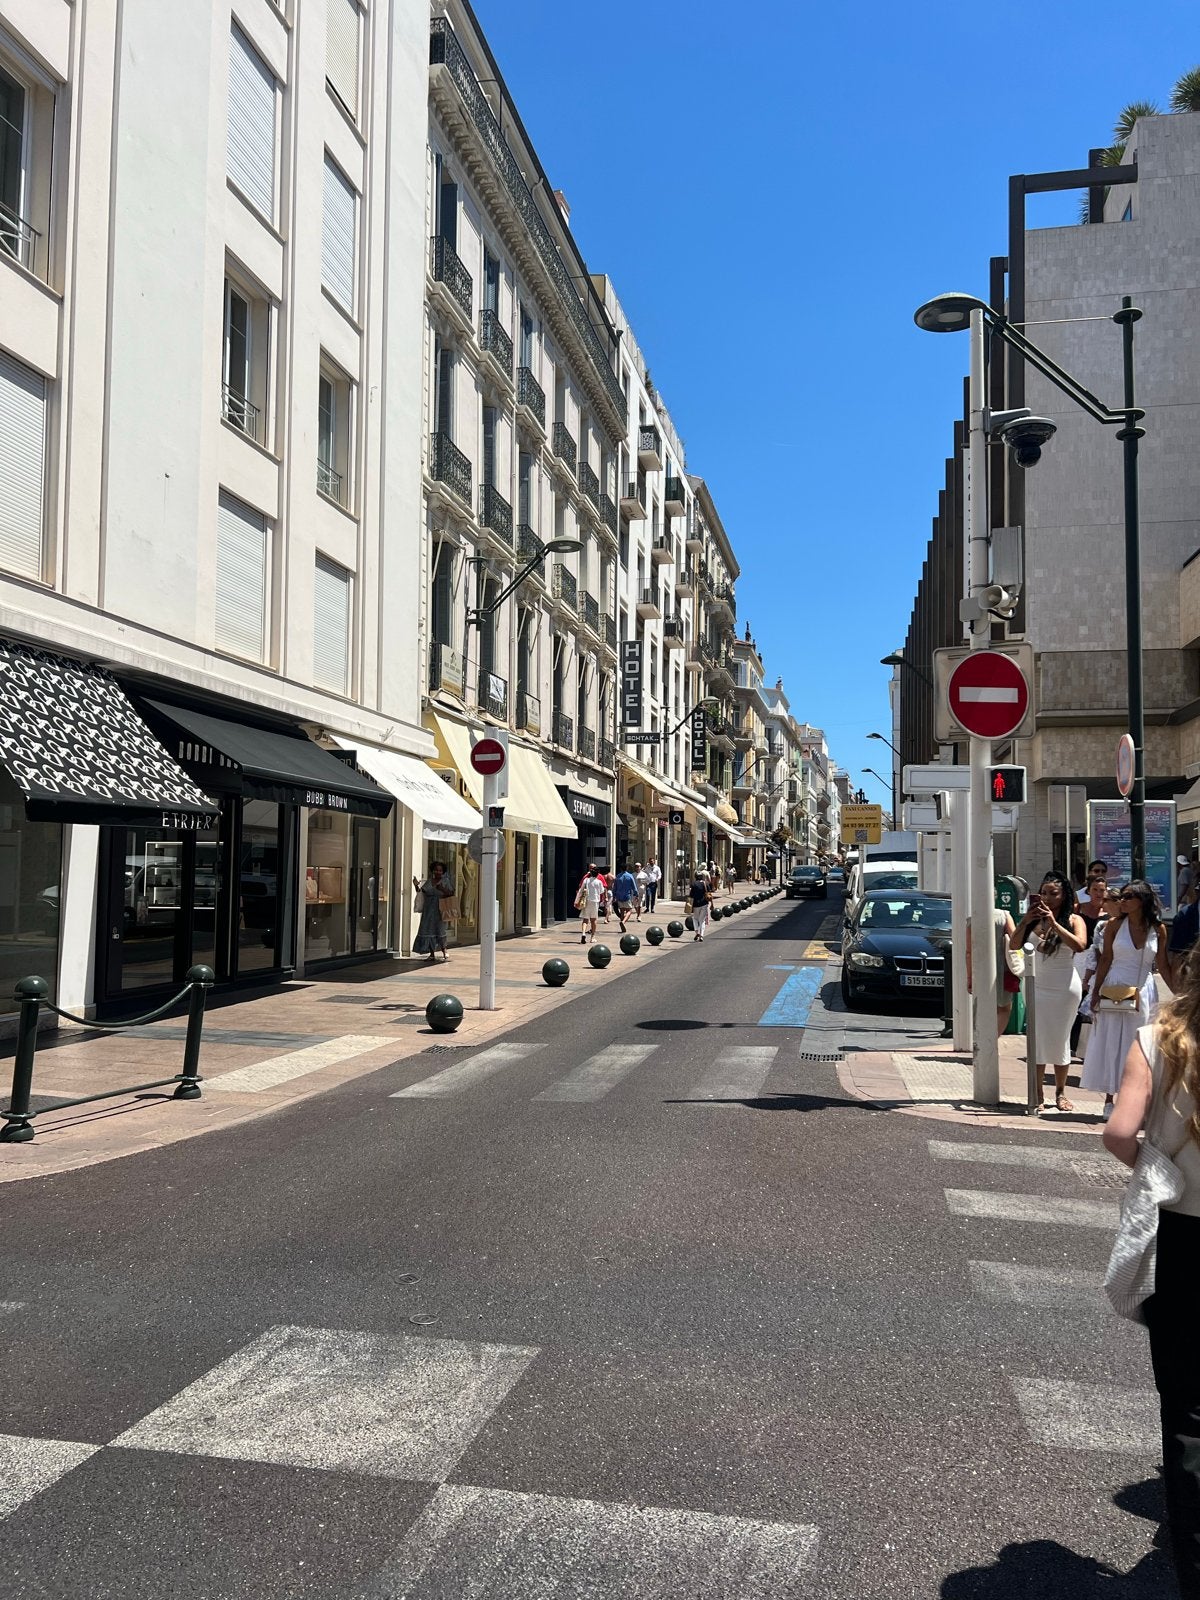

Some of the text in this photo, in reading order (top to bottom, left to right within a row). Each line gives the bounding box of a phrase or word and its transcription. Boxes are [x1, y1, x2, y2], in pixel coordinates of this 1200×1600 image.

[625, 644, 639, 723] HOTEL
[694, 713, 704, 758] HOTEL
[327, 793, 348, 809] BROWN
[573, 799, 595, 818] SEPHORA
[162, 811, 212, 829] ETRIER
[907, 976, 920, 984] 515
